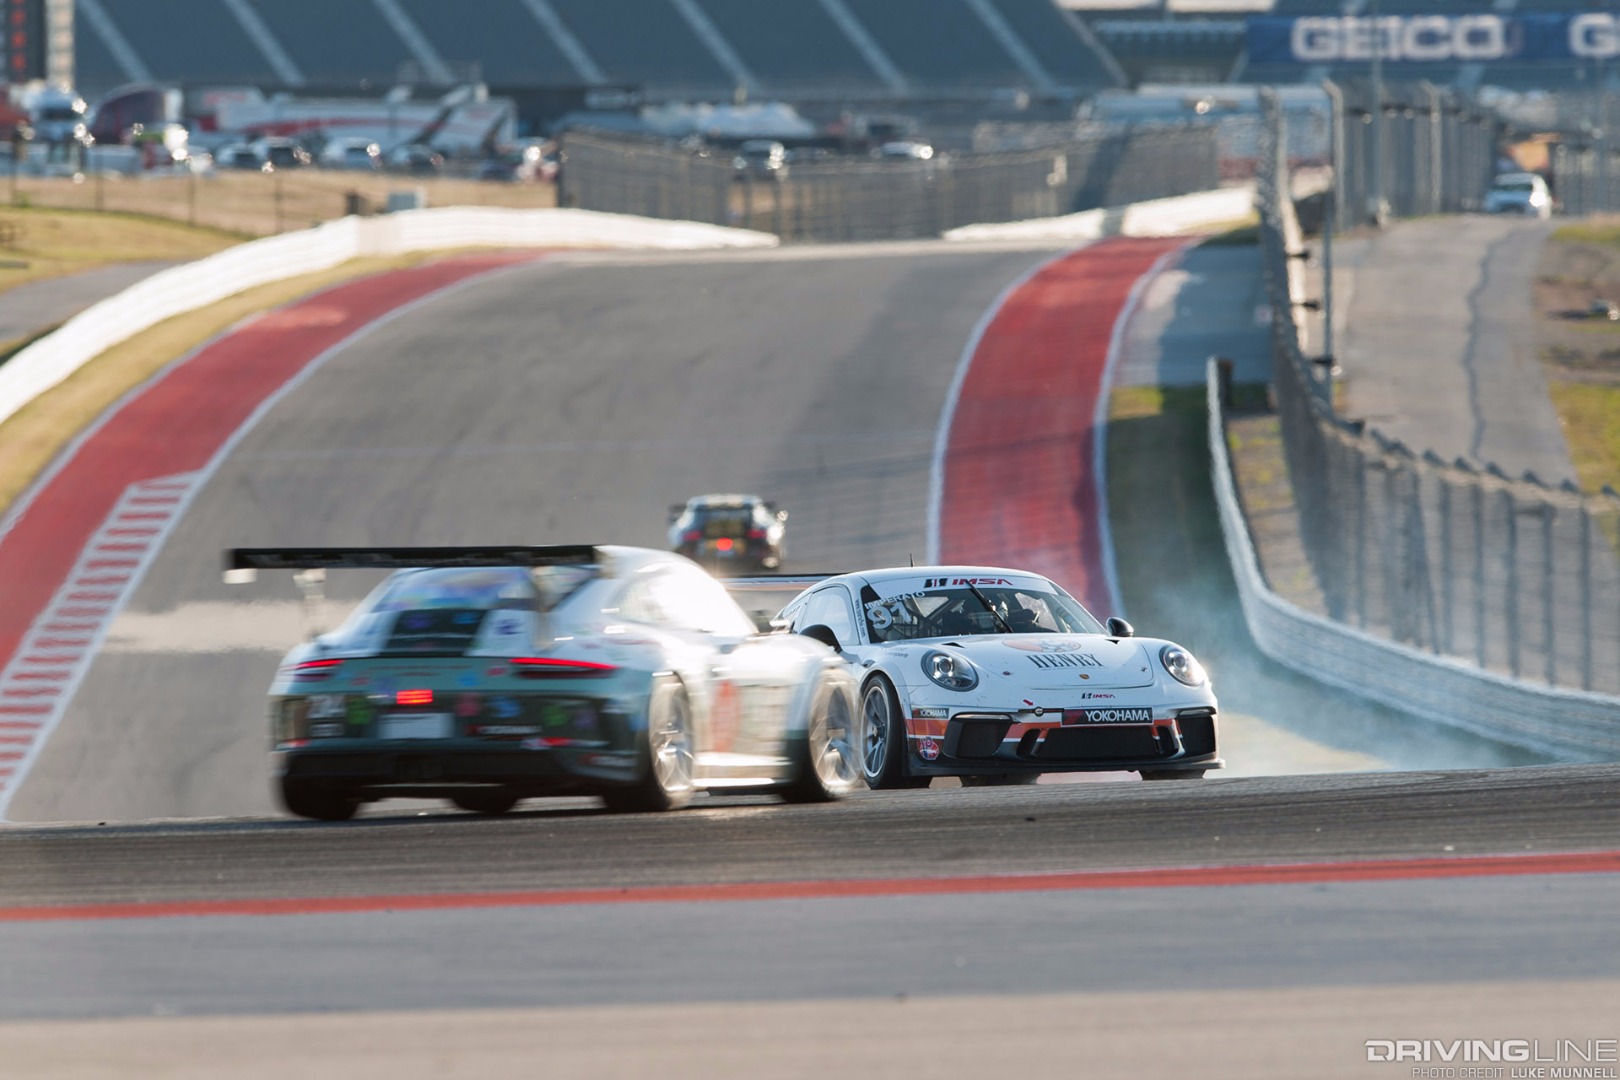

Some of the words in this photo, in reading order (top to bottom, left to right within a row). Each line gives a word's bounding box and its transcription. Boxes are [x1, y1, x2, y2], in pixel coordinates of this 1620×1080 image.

[1290, 15, 1506, 61] GEICO
[952, 578, 1014, 586] IMSA
[867, 600, 912, 630] 91
[1026, 653, 1104, 669] HENRY
[1085, 709, 1151, 722] YOKOHAMA
